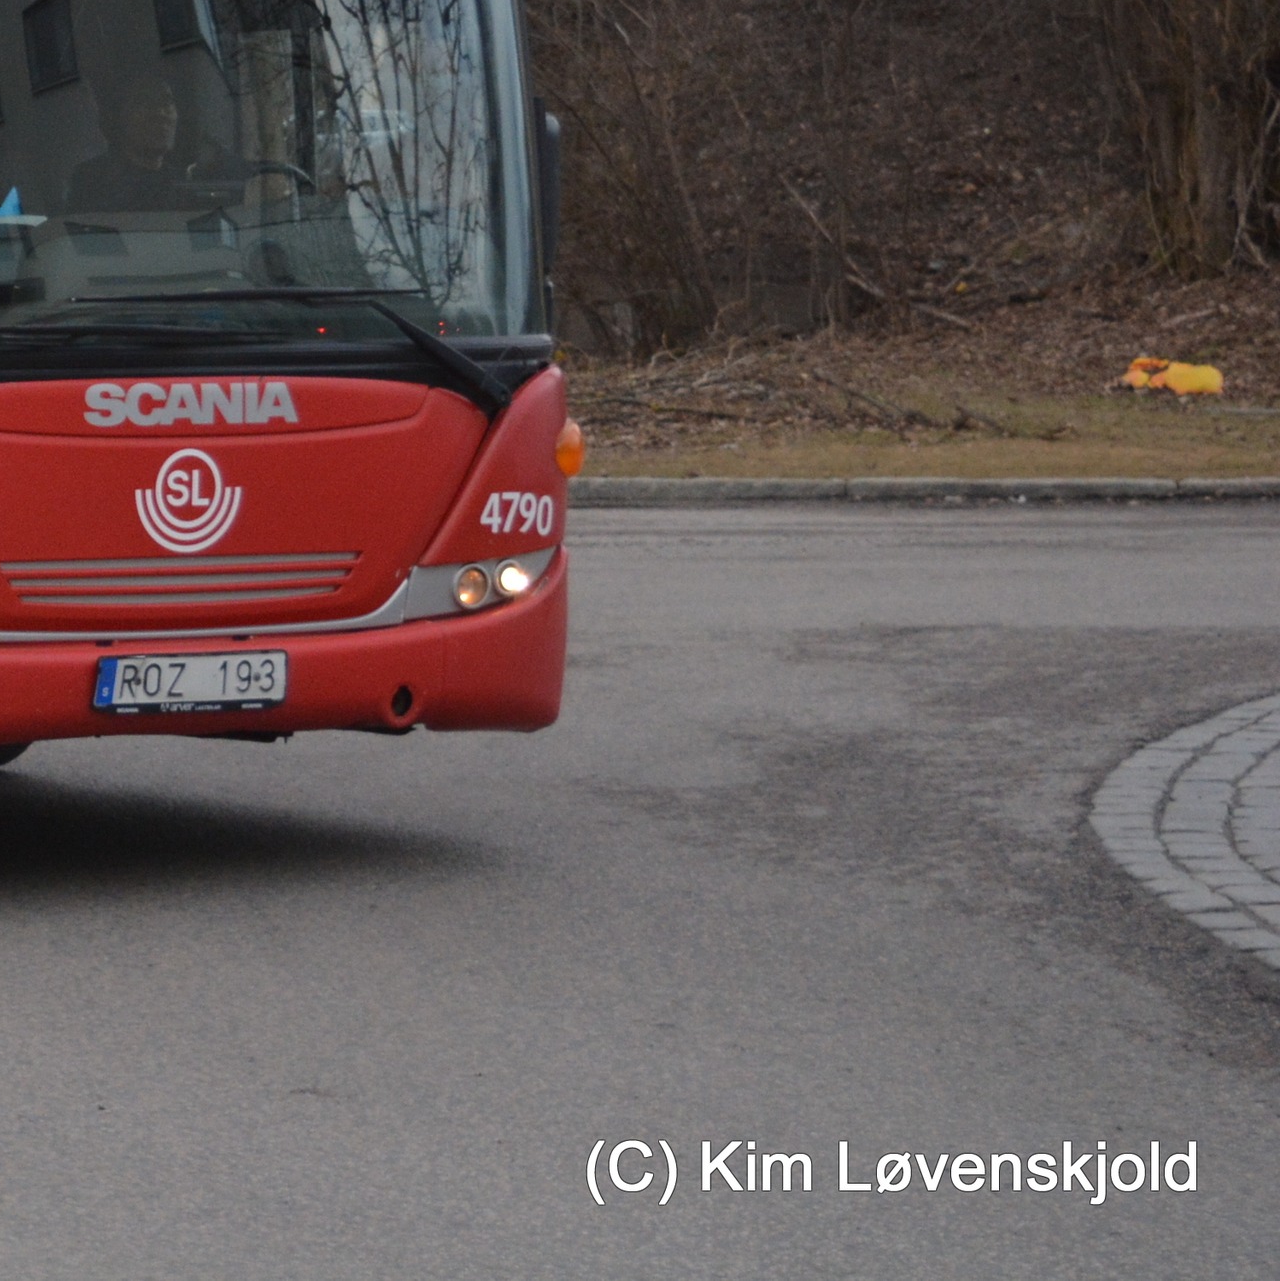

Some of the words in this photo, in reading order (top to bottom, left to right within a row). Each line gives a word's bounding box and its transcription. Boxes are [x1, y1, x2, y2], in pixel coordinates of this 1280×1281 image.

[83, 381, 299, 428] SCANIA
[166, 468, 210, 507] SL
[480, 490, 554, 537] 4790
[118, 662, 187, 700] ROZ
[218, 658, 277, 696] 193
